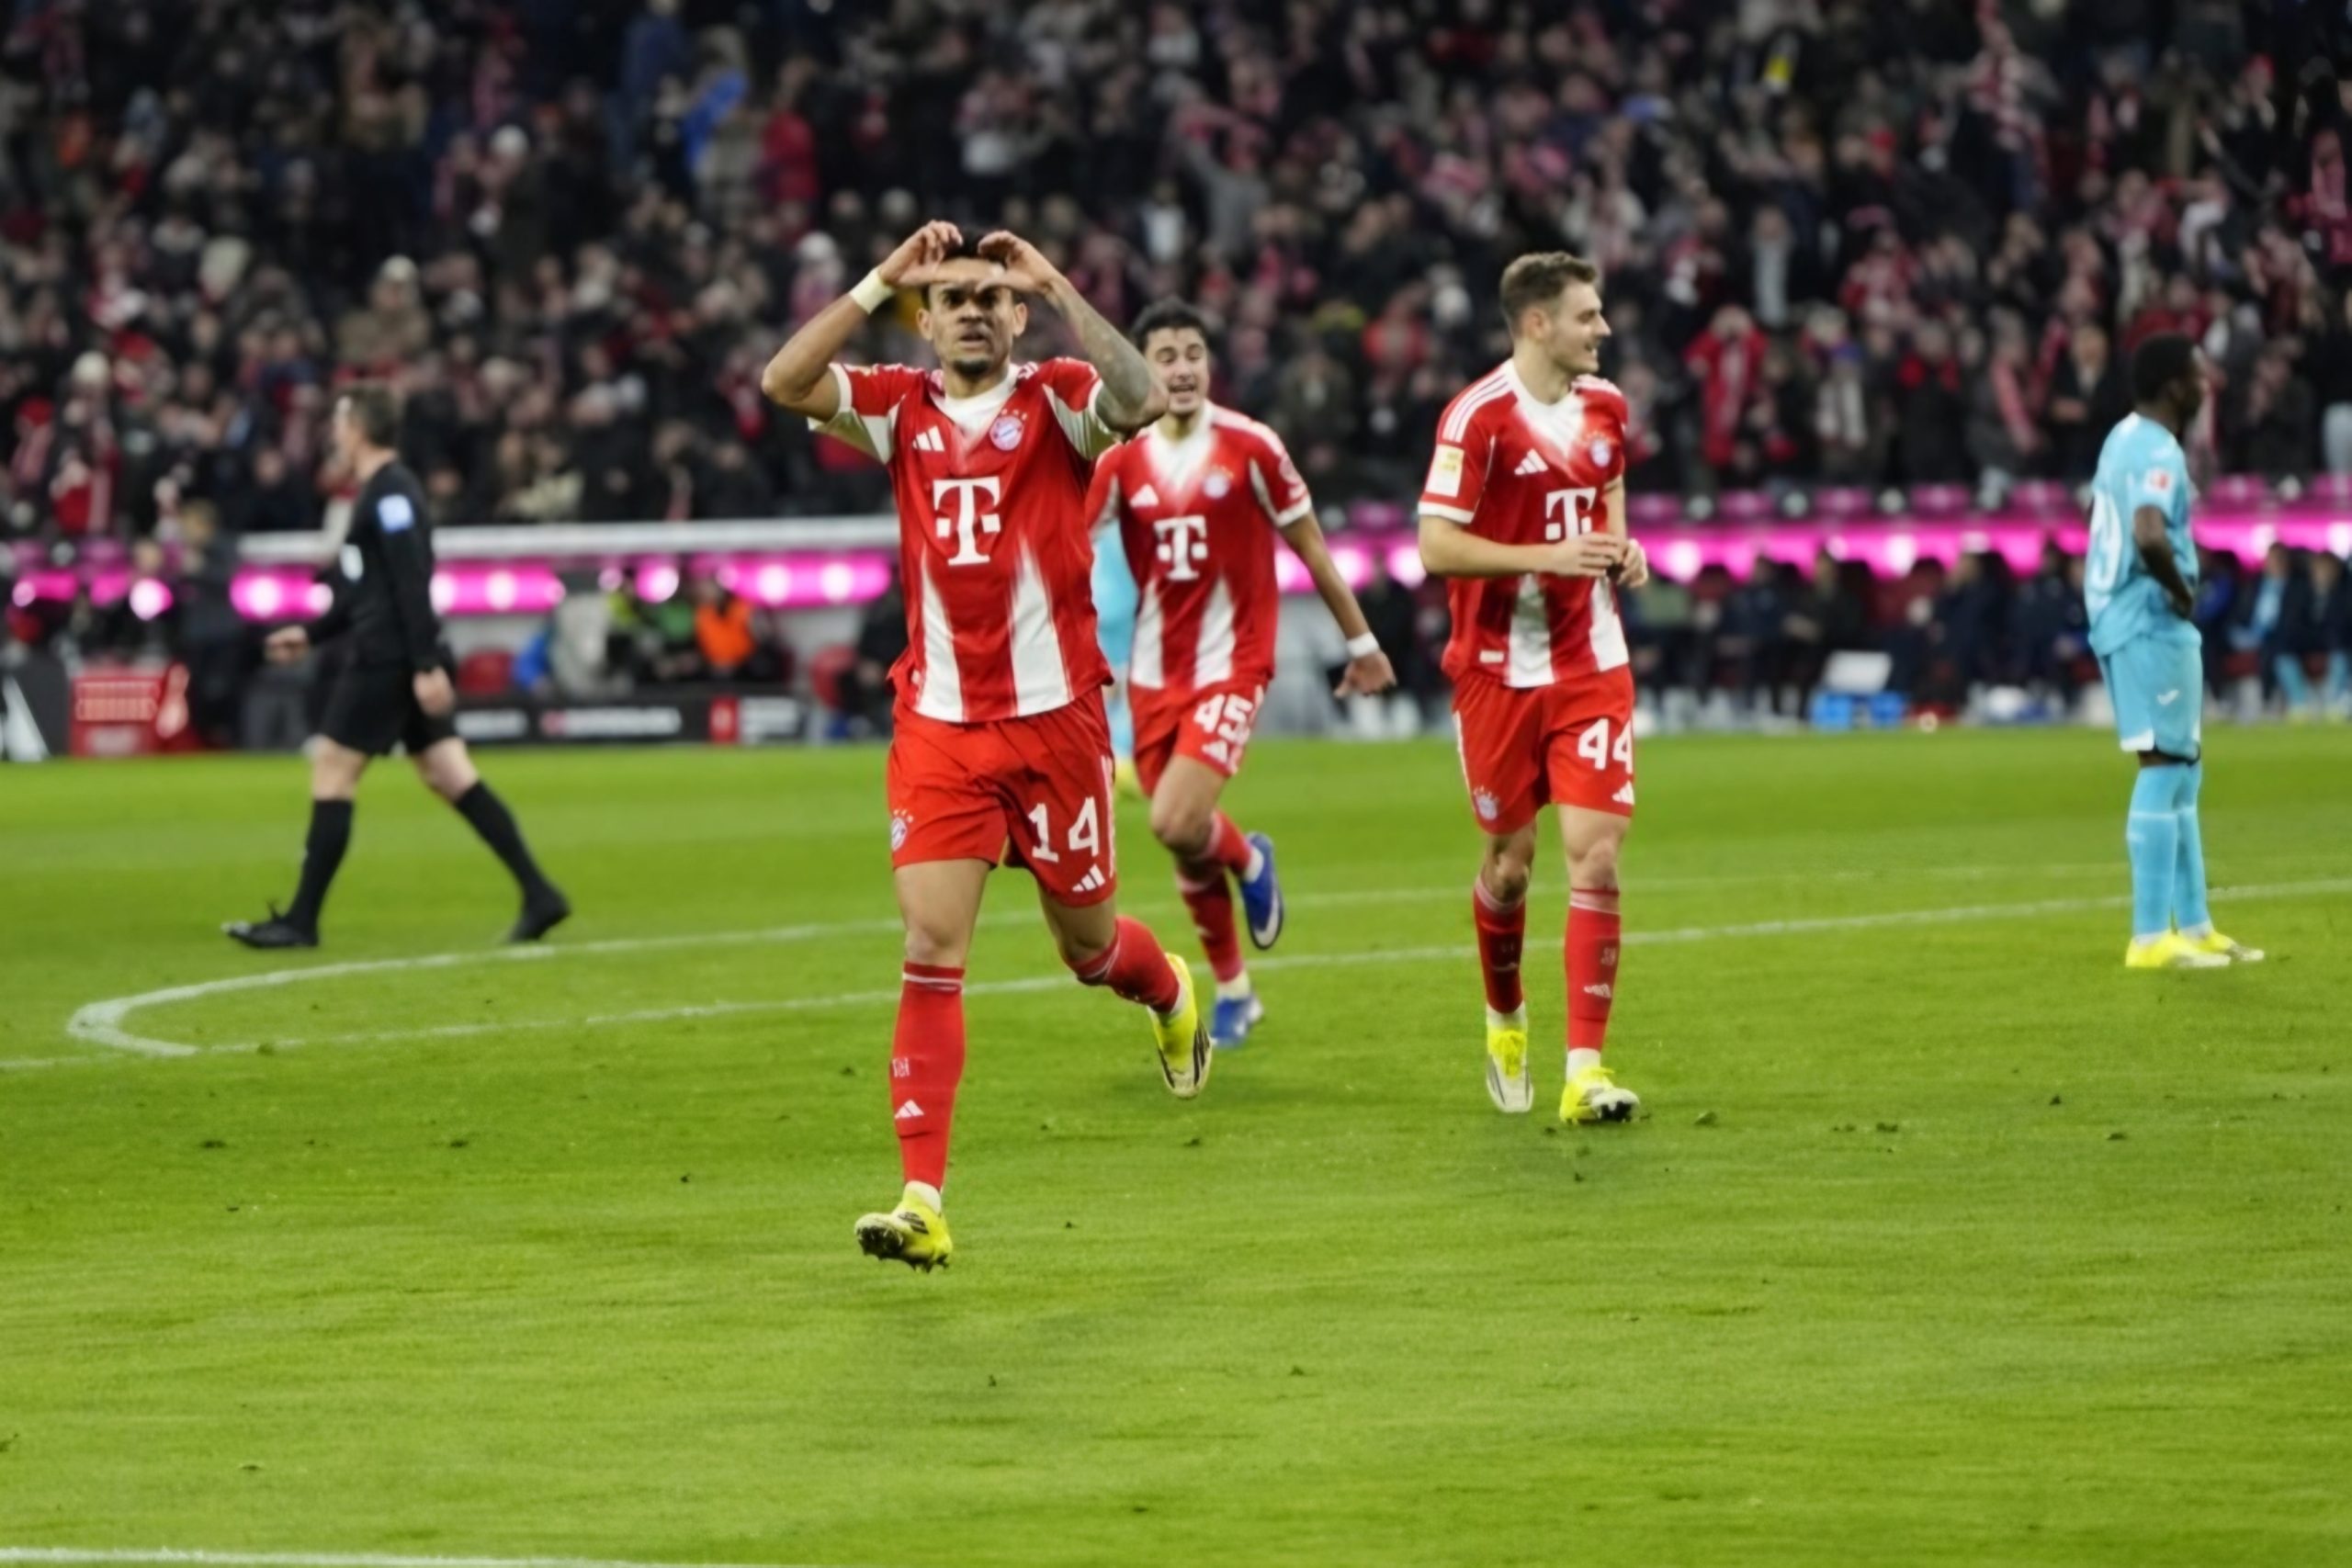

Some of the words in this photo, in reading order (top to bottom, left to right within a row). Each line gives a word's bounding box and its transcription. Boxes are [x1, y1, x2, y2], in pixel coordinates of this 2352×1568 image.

[933, 476, 1001, 566] T
[1153, 514, 1208, 581] T
[1193, 694, 1253, 745] 45
[1577, 717, 1633, 774] 44
[1028, 795, 1099, 863] 14
